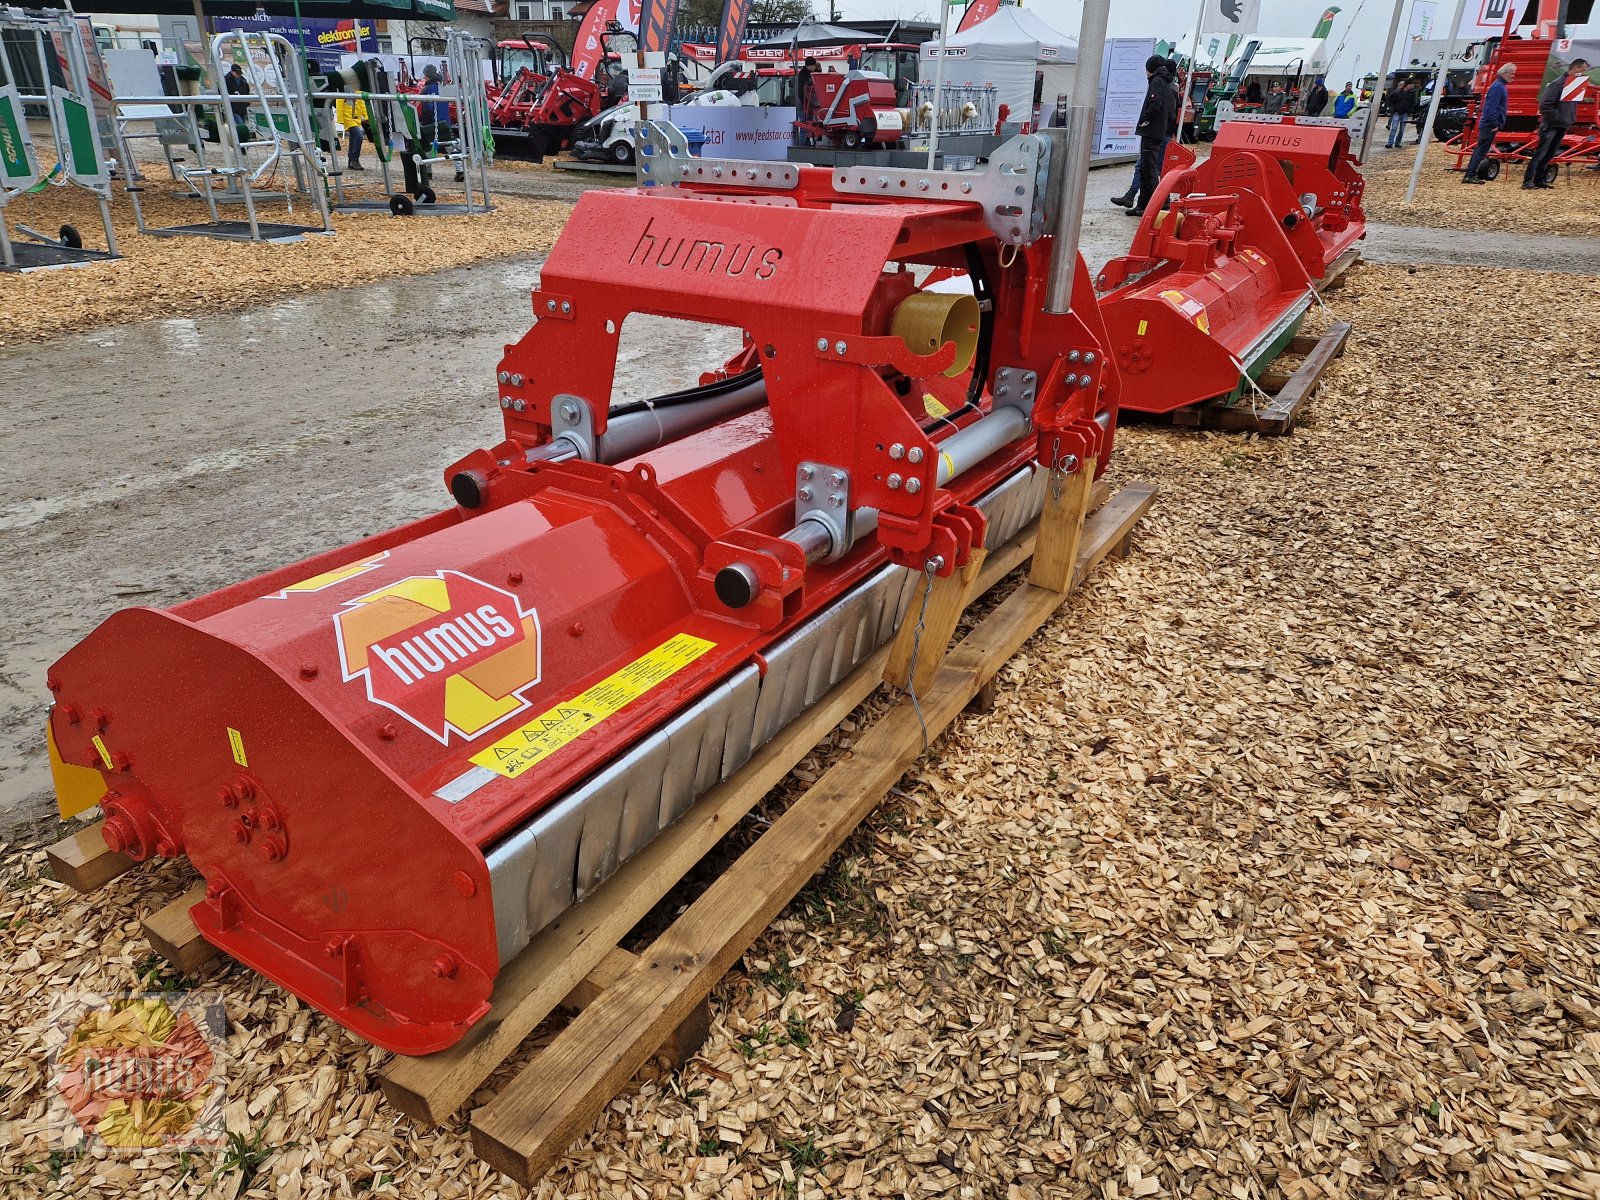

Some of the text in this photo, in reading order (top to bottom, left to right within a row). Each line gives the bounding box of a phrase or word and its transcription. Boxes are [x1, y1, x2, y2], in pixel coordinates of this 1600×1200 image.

[269, 27, 287, 35] mach
[1560, 40, 1569, 49] 3
[748, 50, 784, 58] EDER
[804, 46, 843, 57] EDER
[1245, 129, 1302, 147] humus
[628, 216, 783, 280] humus
[370, 603, 515, 685] humus
